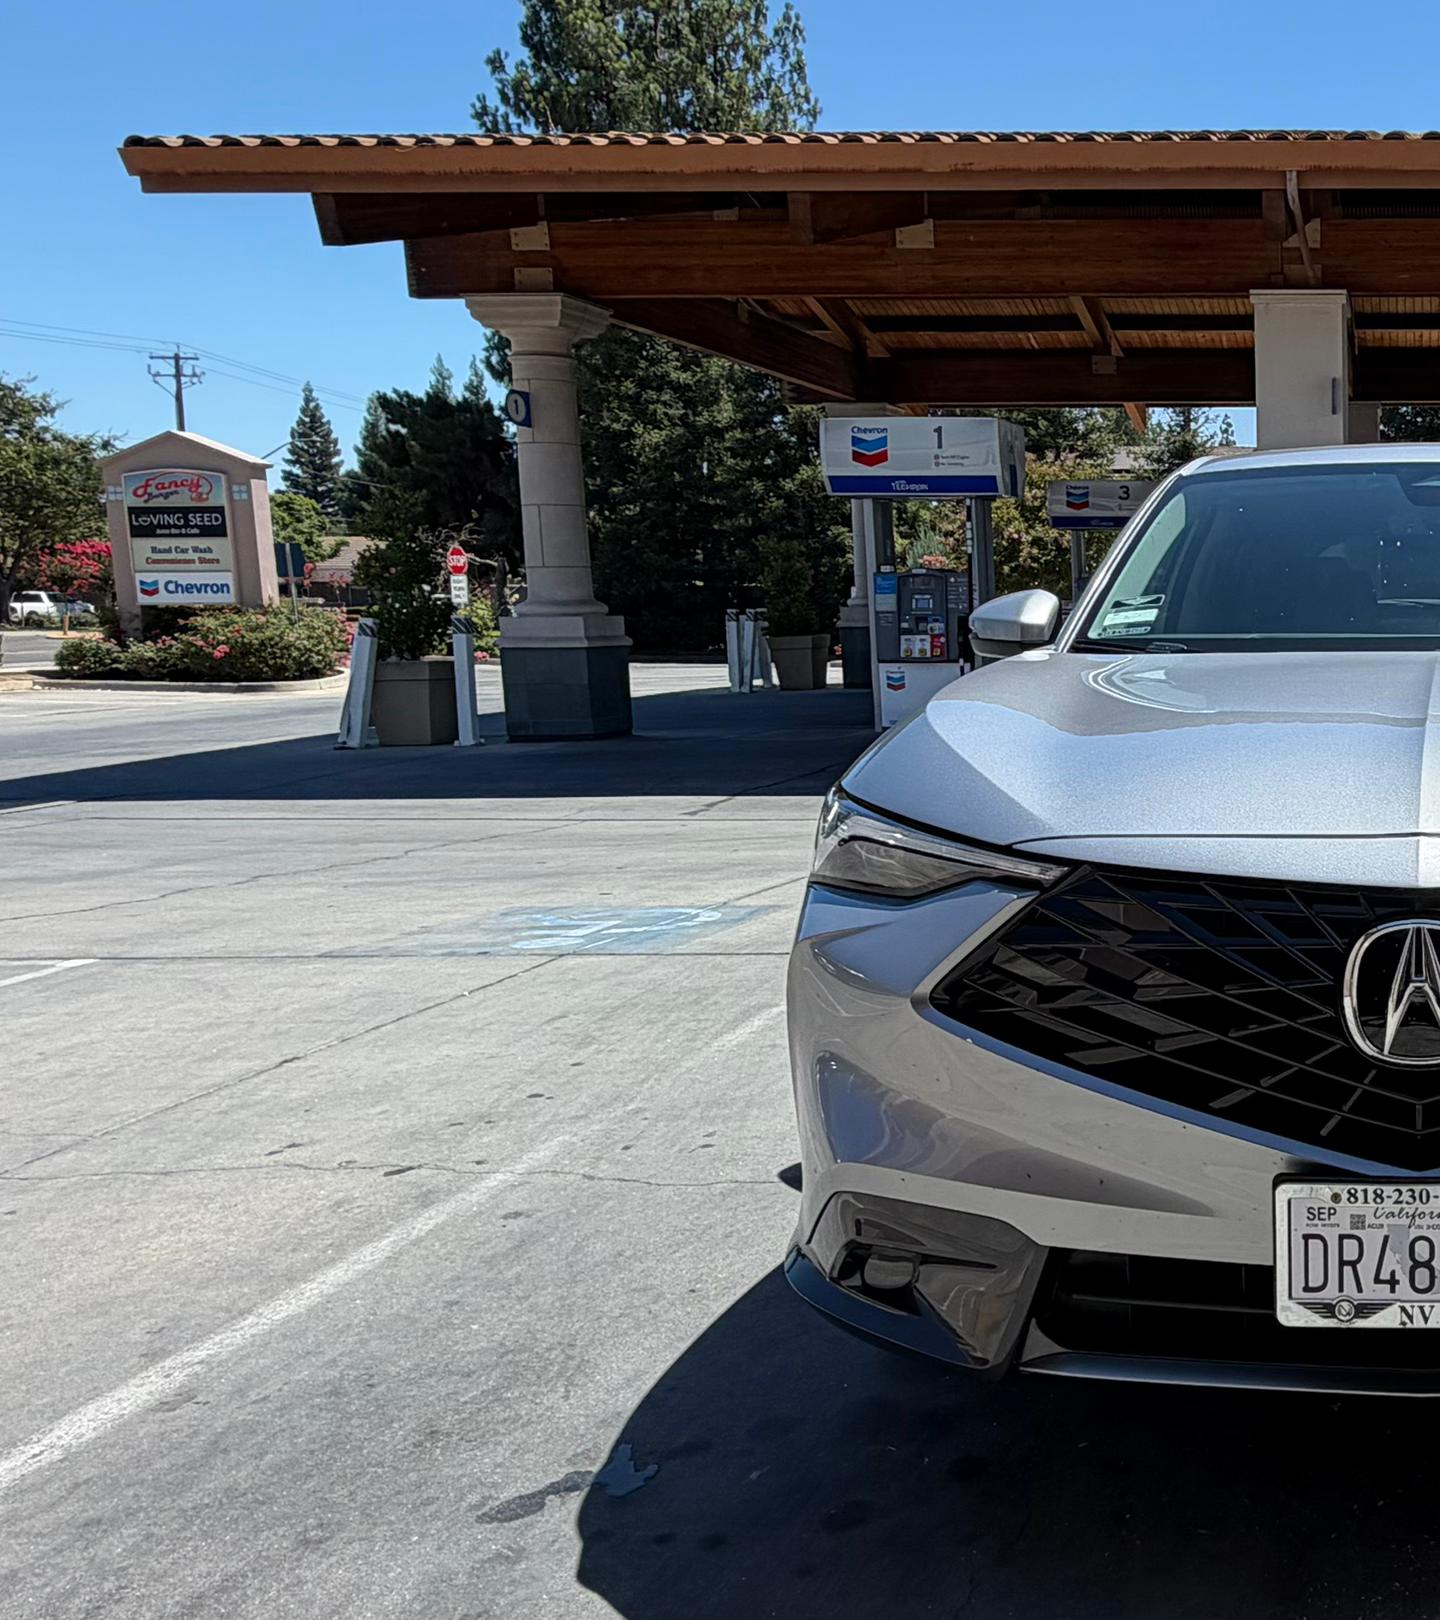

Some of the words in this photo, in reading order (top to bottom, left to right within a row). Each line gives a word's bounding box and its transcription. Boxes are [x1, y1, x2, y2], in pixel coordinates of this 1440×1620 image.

[850, 425, 889, 435] Chevron
[932, 425, 943, 450] 1
[132, 475, 203, 499] Fancy
[1118, 485, 1130, 500] 3
[188, 513, 223, 526] SEED
[150, 546, 173, 554] Hand
[174, 546, 190, 554] Car
[191, 546, 214, 554] Wash
[163, 580, 231, 595] Chevron
[1306, 1206, 1337, 1221] SEP
[1398, 1304, 1435, 1327] NV
